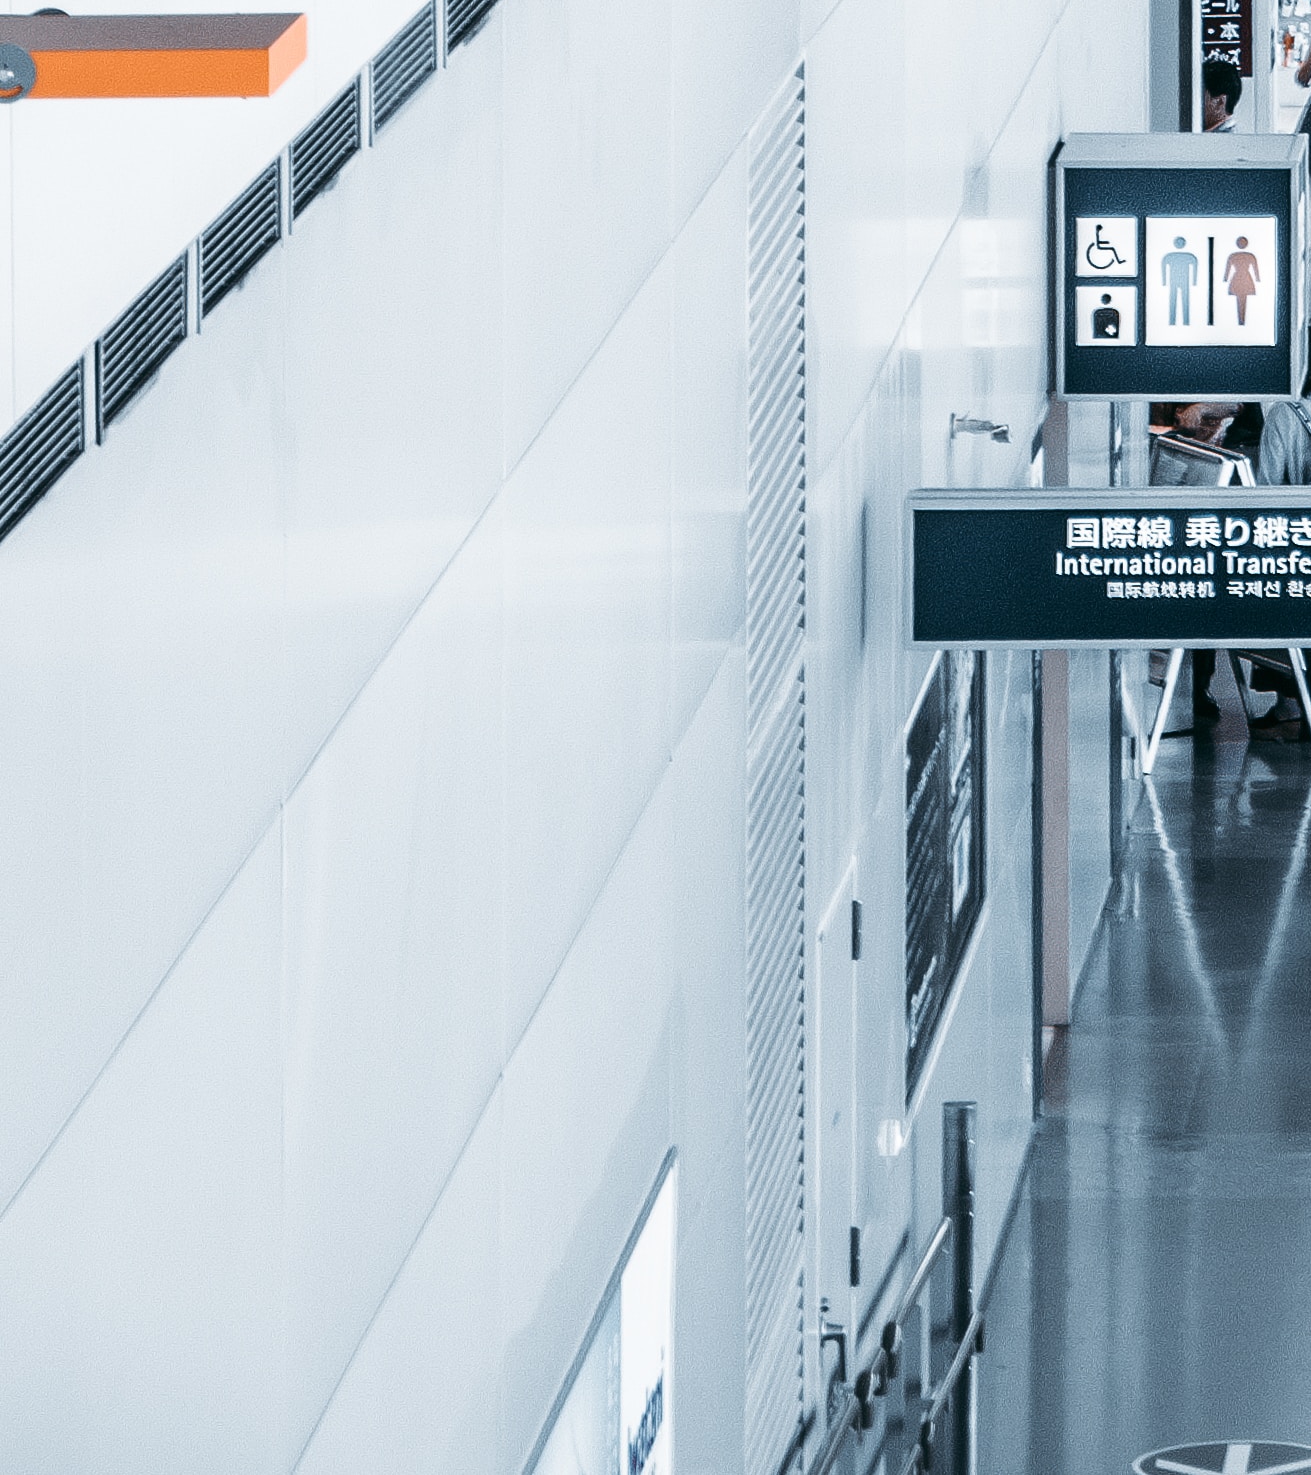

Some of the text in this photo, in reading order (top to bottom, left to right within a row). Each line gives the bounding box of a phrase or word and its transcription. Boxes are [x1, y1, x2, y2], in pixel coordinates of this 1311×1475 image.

[1065, 516, 1173, 549] 国際線
[1056, 551, 1216, 576] International
[1226, 580, 1282, 599] 국제선
